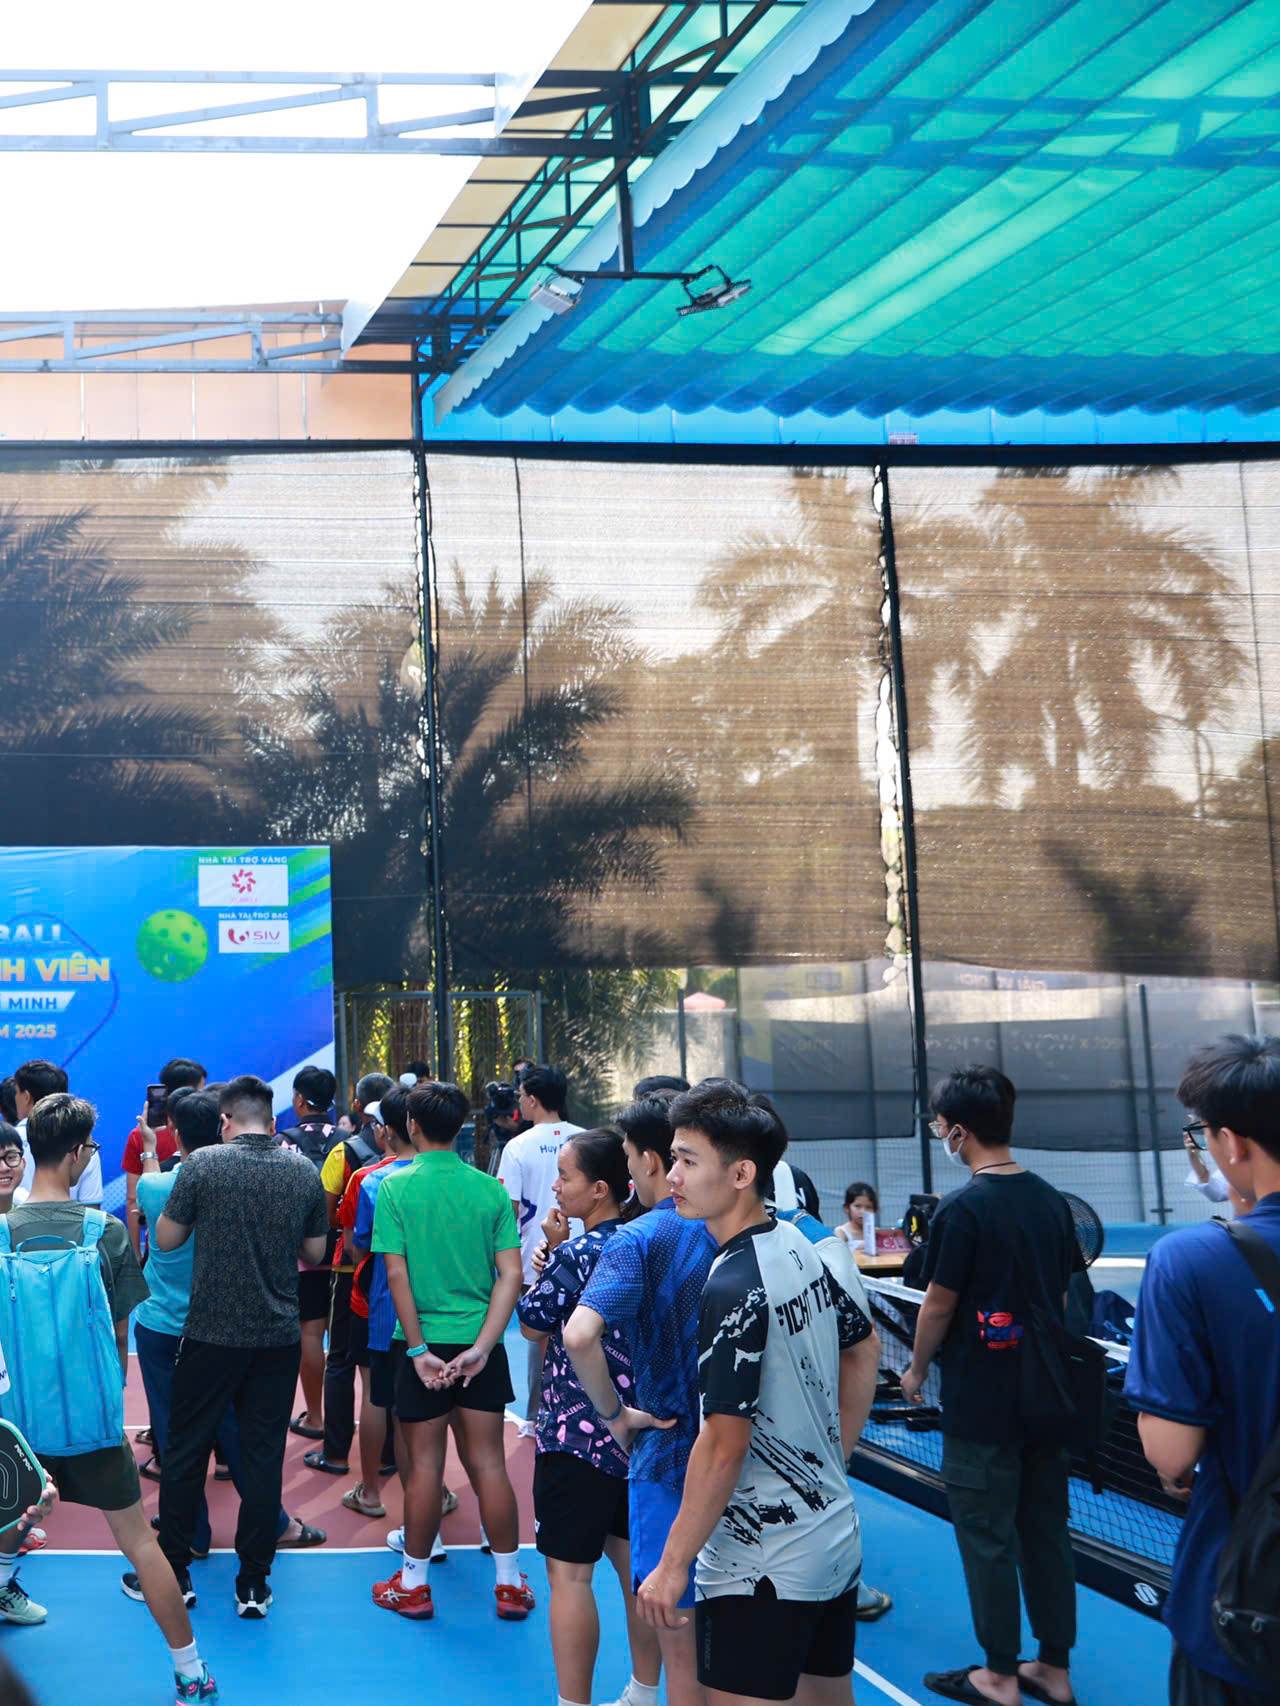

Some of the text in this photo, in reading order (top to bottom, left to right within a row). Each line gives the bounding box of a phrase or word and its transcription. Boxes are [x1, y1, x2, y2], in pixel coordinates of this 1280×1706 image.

[253, 930, 280, 940] SIV
[35, 952, 110, 982] VIÊN
[9, 997, 57, 1009] MINH
[15, 1023, 58, 1039] 2025
